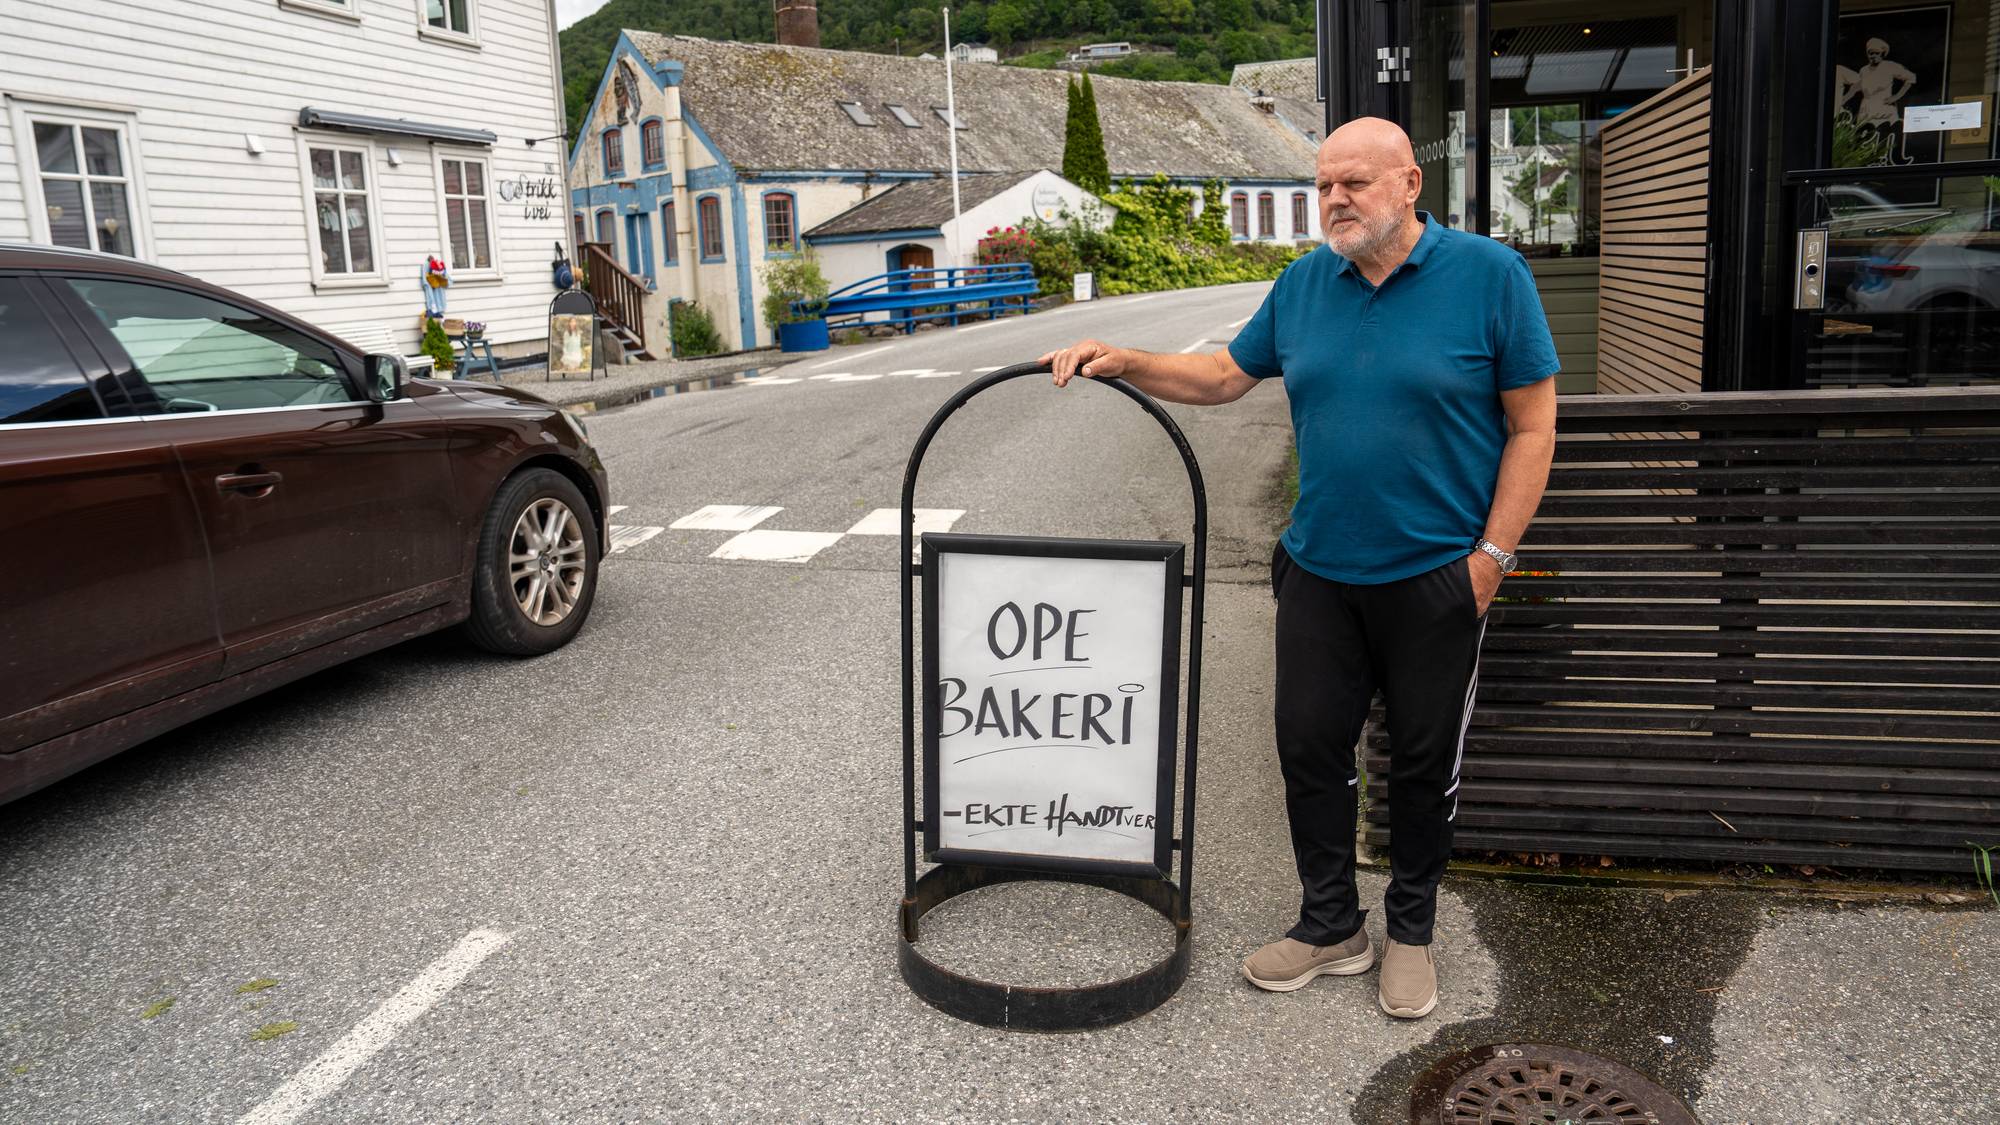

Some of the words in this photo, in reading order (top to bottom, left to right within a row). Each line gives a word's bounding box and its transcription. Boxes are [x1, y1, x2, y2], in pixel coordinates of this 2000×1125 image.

[514, 174, 557, 199] Strikk
[987, 601, 1097, 662] OPE
[1040, 793, 1156, 837] HANDTVER
